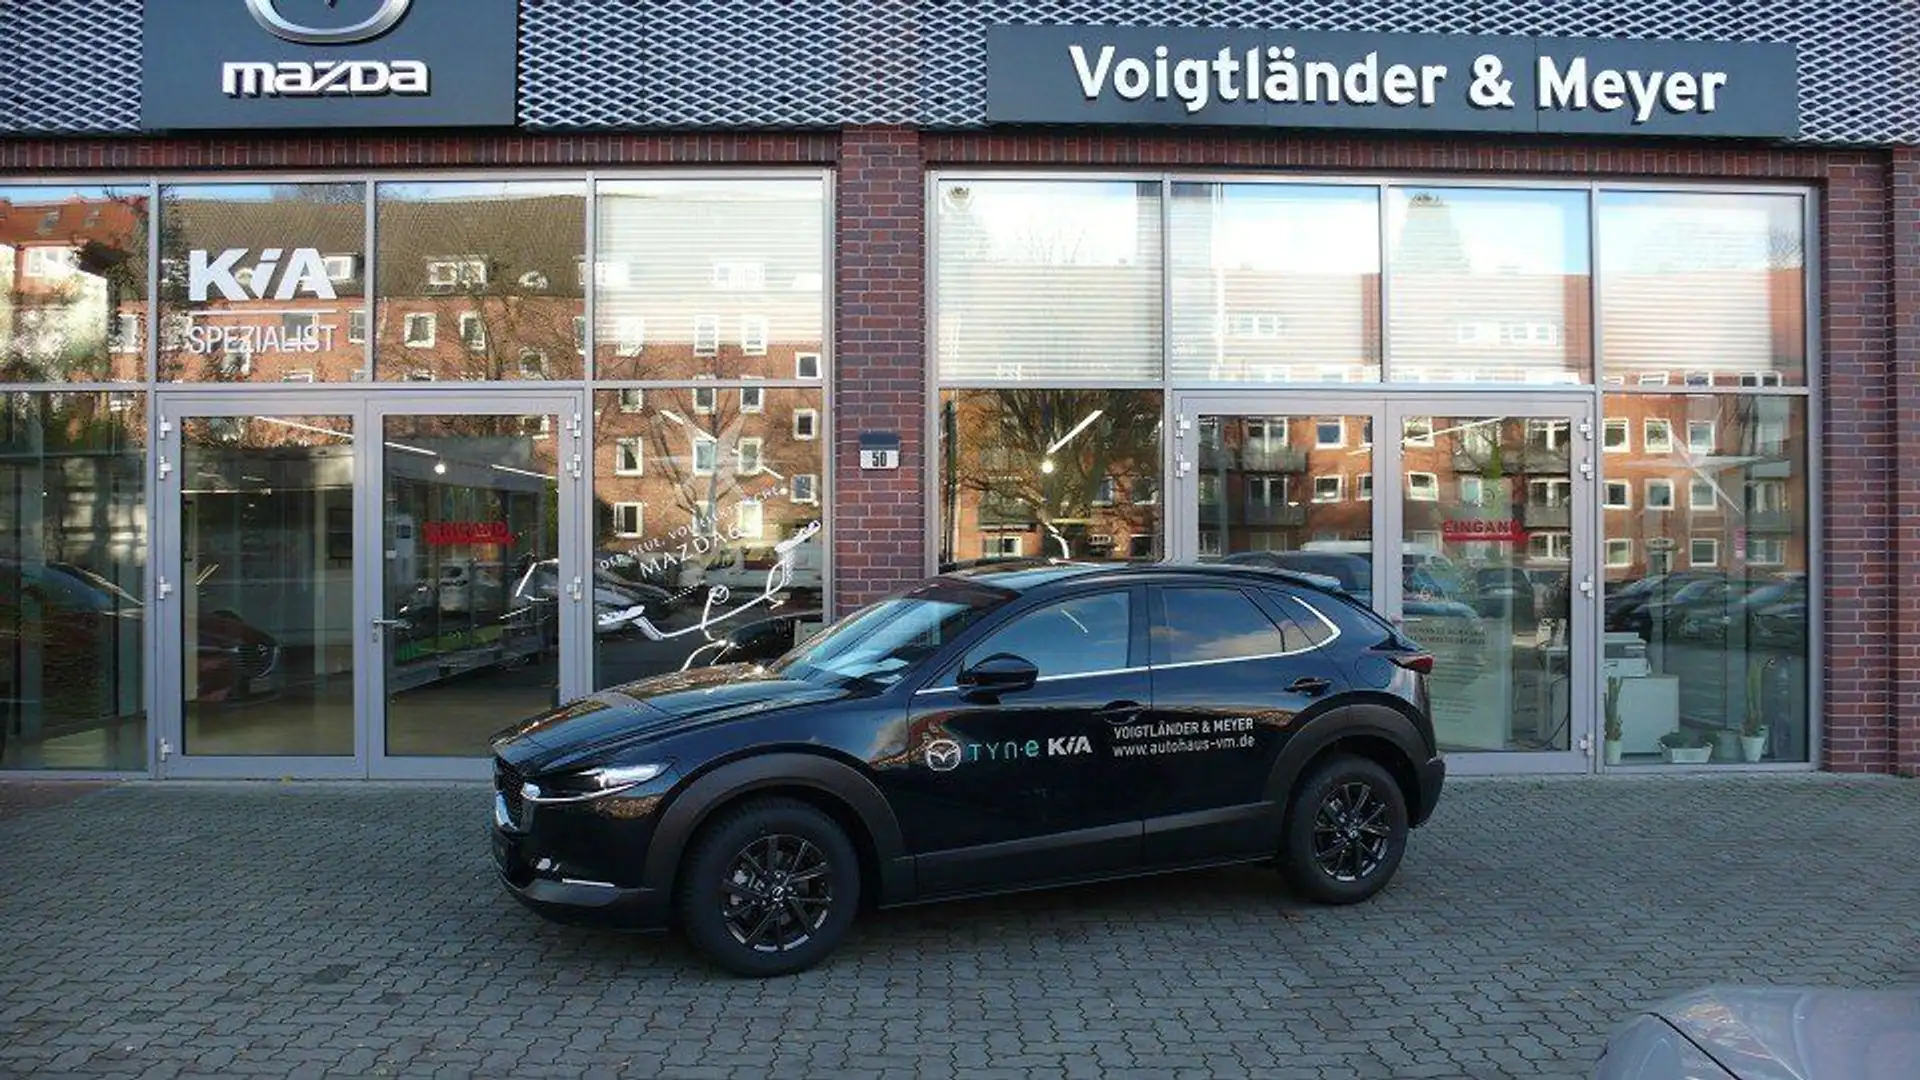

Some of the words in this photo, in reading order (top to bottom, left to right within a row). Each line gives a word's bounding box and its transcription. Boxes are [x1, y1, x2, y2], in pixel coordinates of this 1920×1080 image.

[1068, 44, 1447, 112] Voigtländer
[1469, 54, 1515, 107] &
[1535, 56, 1728, 122] Meyer
[188, 324, 337, 354] SPEZIALIST
[872, 451, 887, 467] 50
[1114, 720, 1199, 739] VOIGTLÄNDER
[1202, 719, 1211, 734] &
[1214, 717, 1254, 733] MEYER
[1112, 733, 1255, 758] www.autohaus-vm.de
